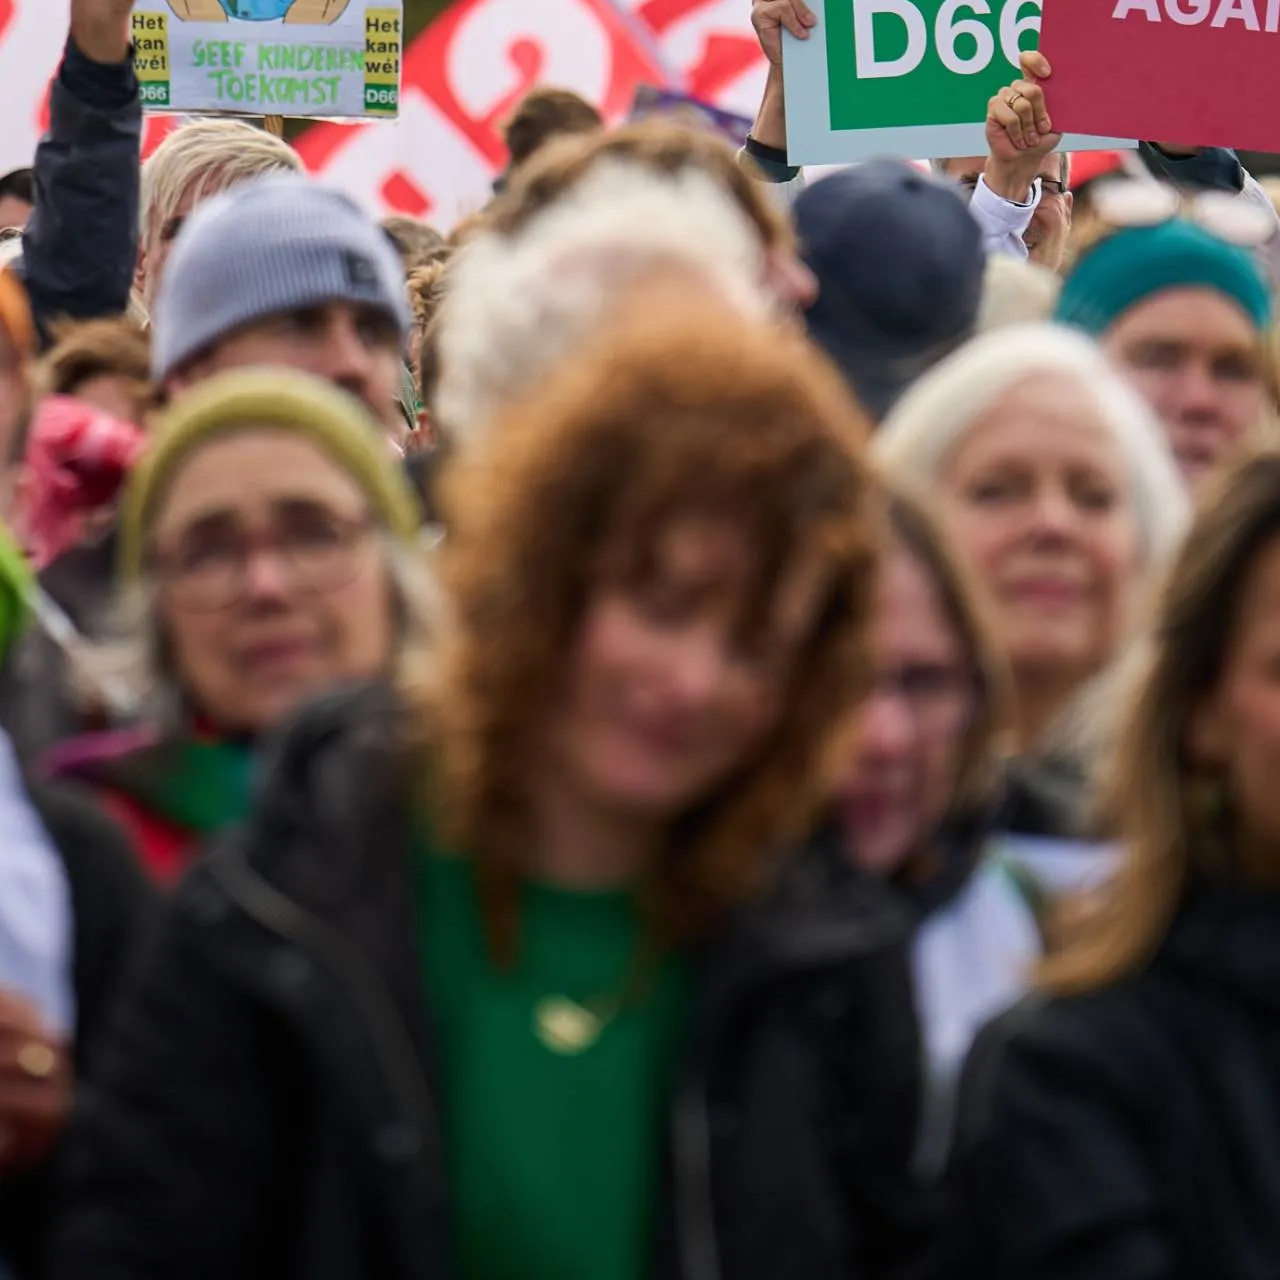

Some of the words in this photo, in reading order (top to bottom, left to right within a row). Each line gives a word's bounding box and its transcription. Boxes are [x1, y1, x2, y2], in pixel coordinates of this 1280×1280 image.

[131, 15, 165, 29] Het
[365, 17, 400, 33] Het
[132, 36, 165, 51] kan
[365, 37, 400, 53] kan
[134, 54, 167, 70] wél
[365, 56, 400, 74] wél
[207, 72, 343, 105] TOEKOMST
[366, 88, 397, 104] D66
